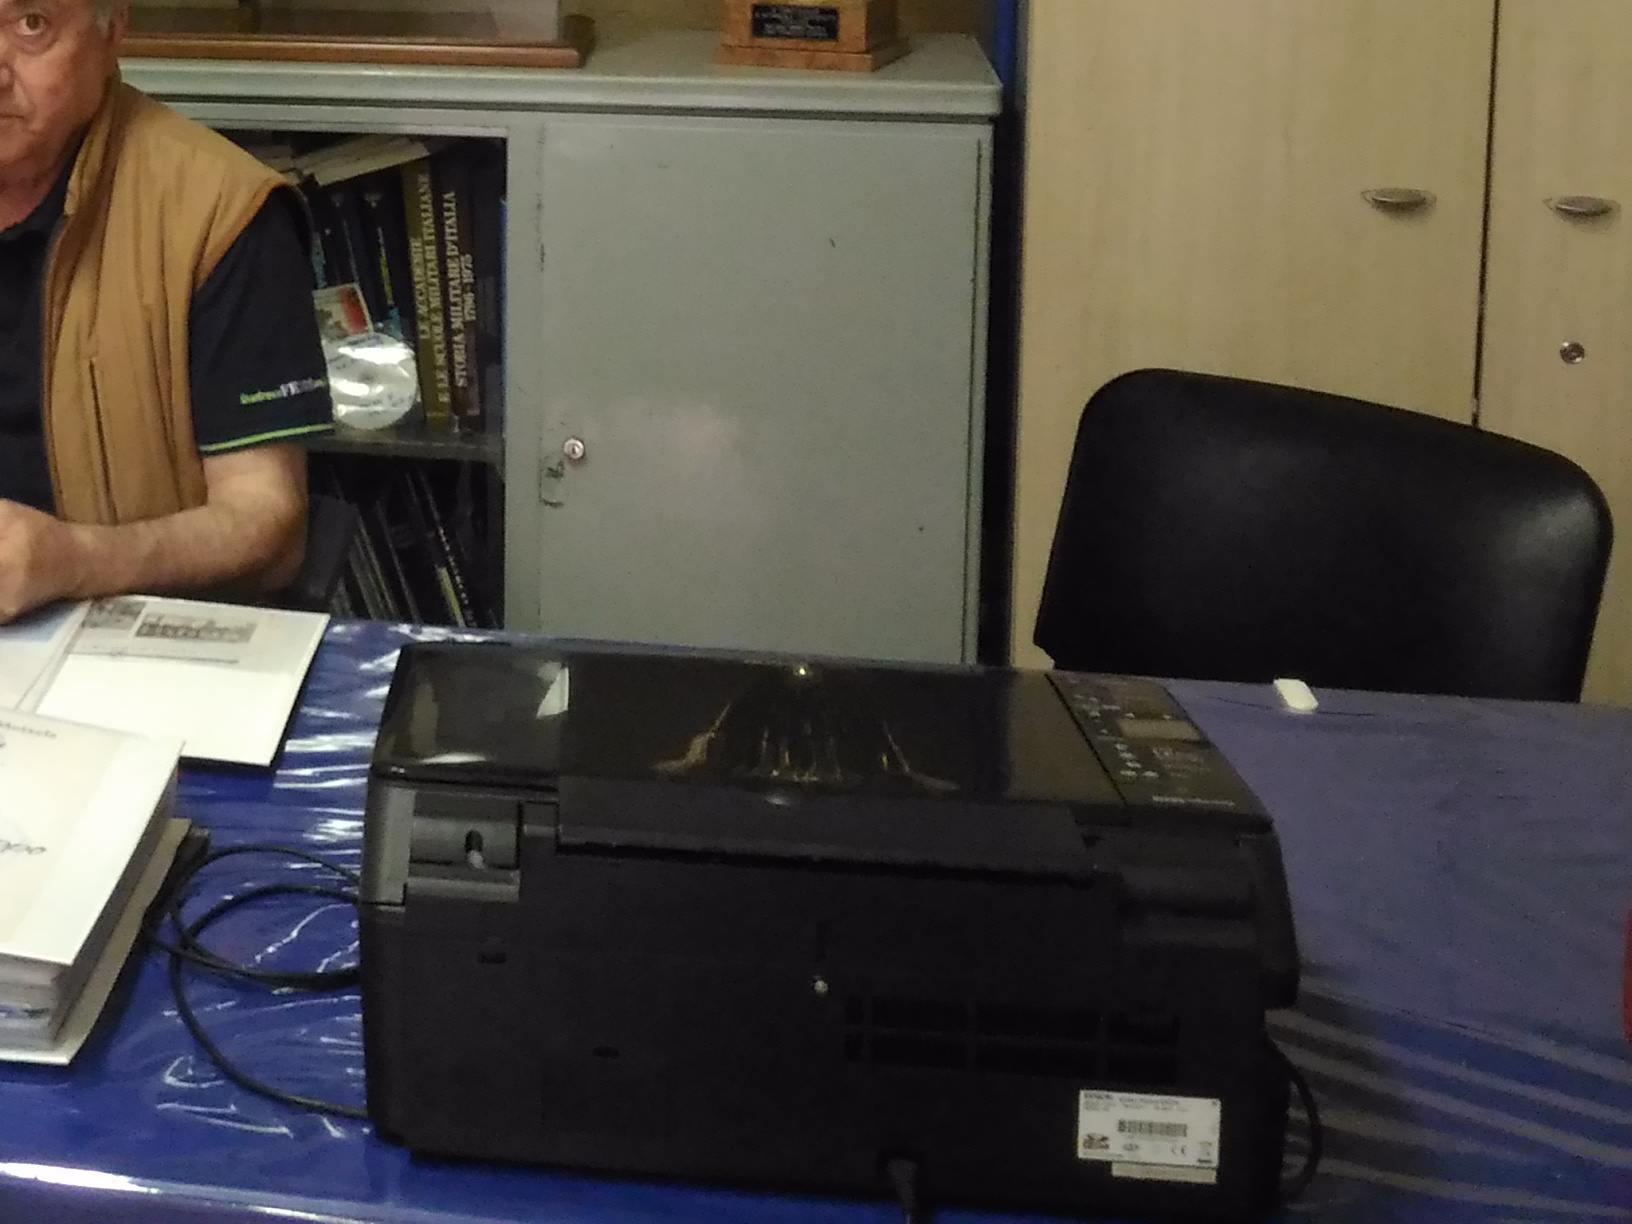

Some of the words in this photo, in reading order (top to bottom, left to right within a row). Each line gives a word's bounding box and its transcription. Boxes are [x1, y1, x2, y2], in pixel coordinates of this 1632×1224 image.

[442, 191, 459, 255] D'ITALIA
[425, 244, 442, 309] MILITARI
[446, 258, 465, 330] MILITARE
[452, 333, 468, 387] STORIA
